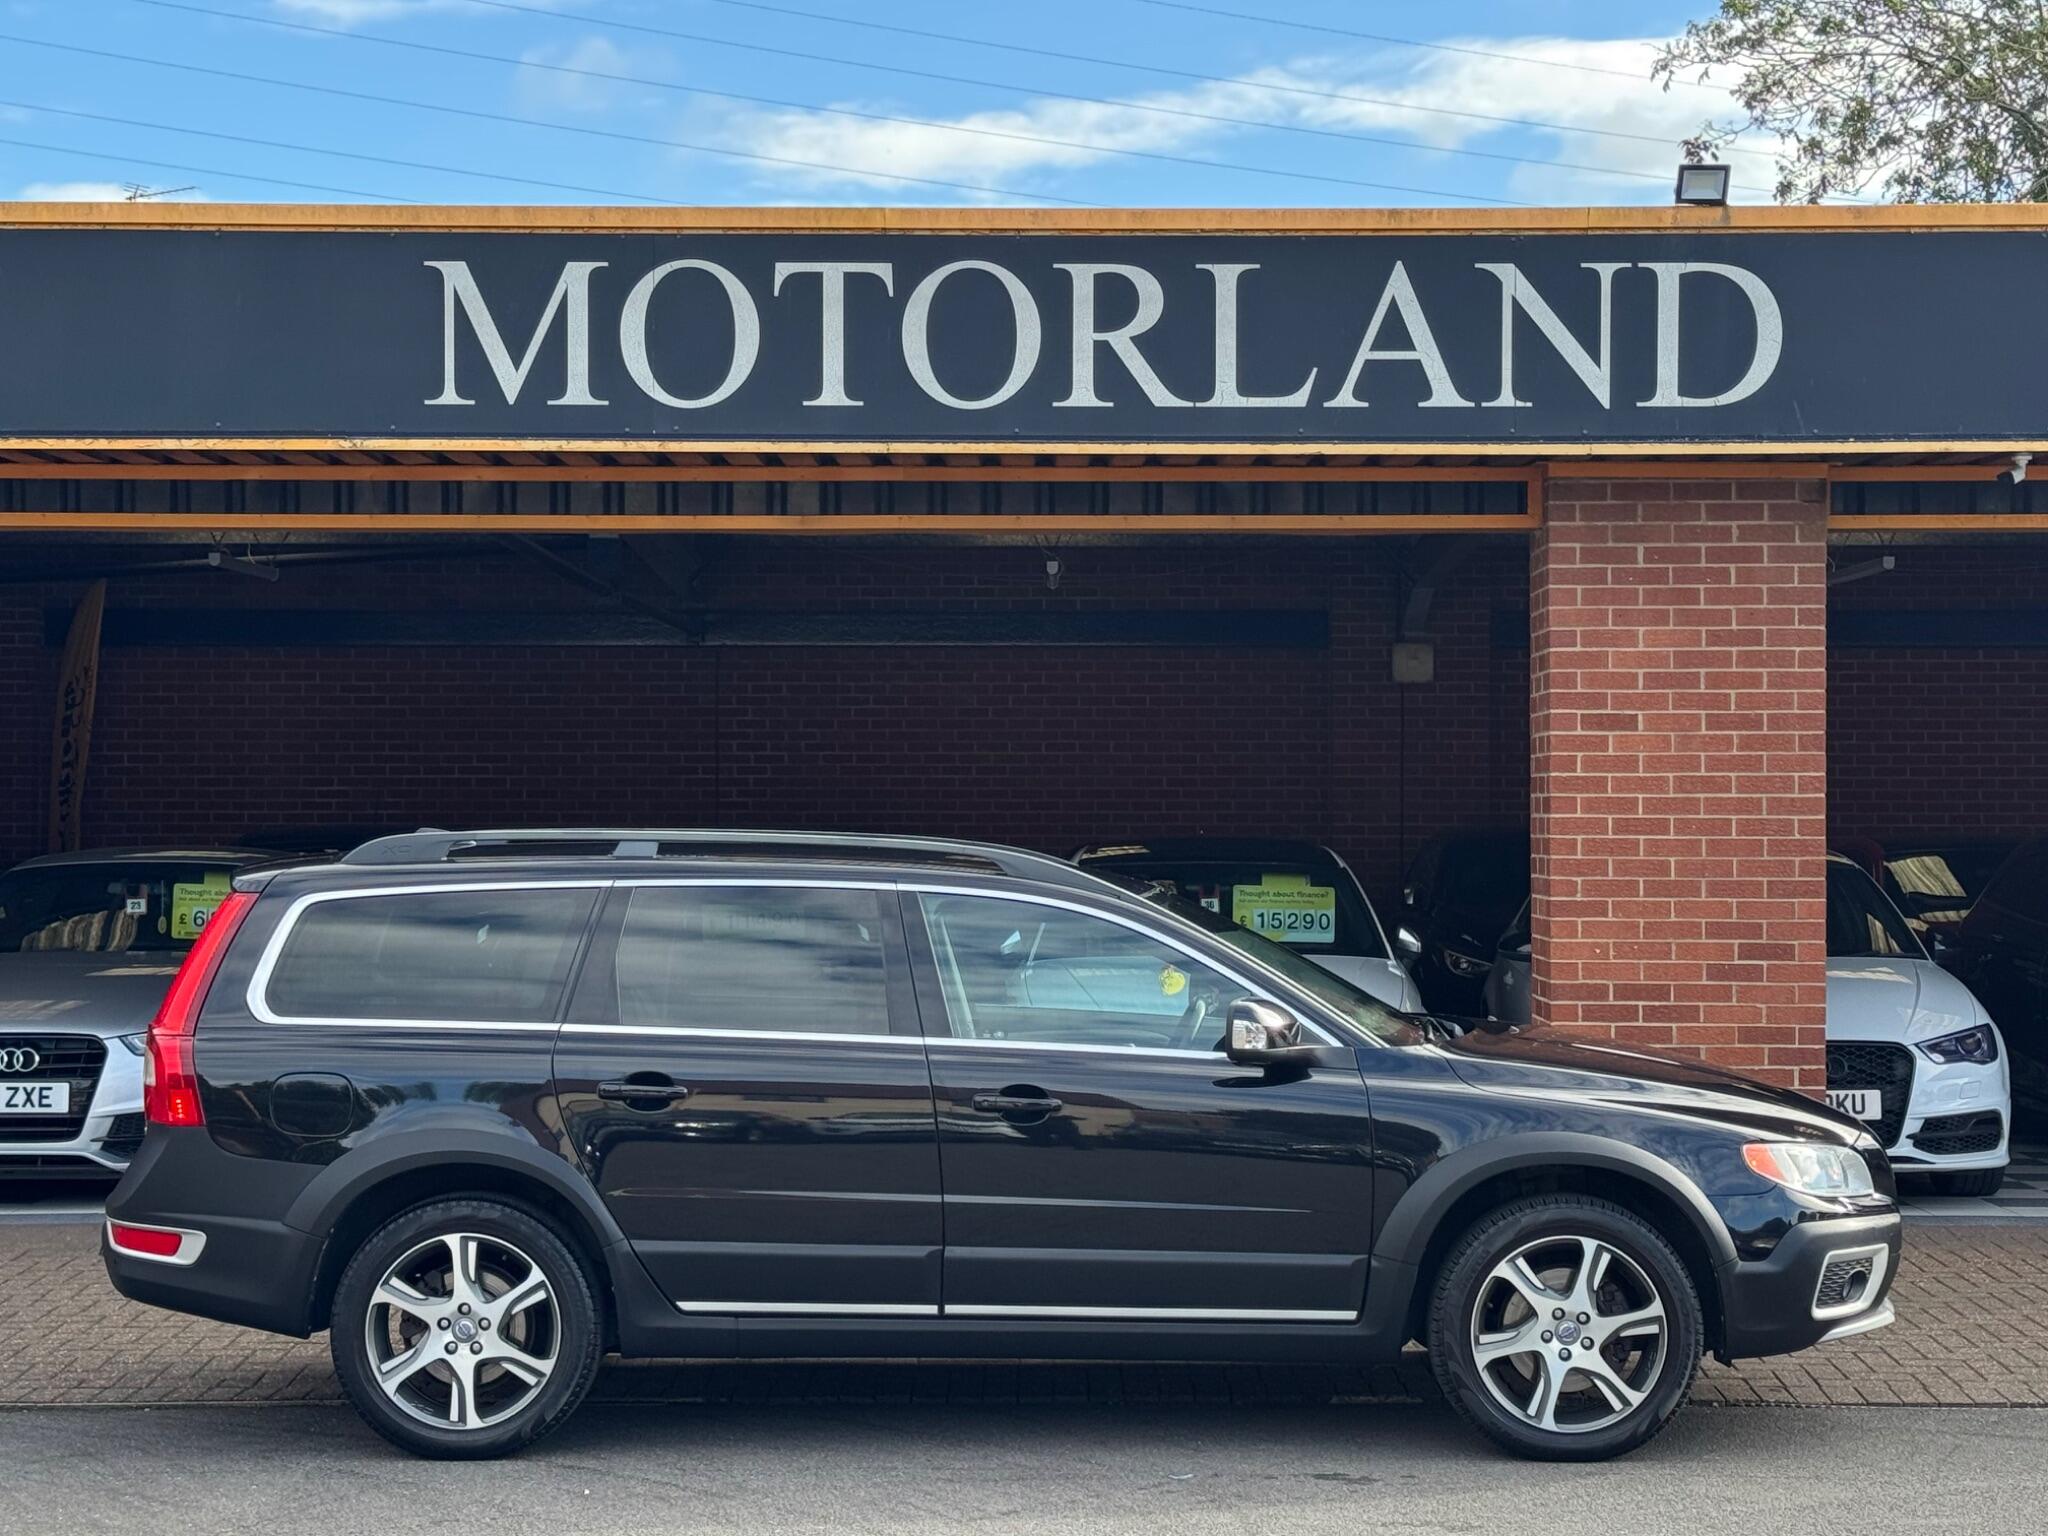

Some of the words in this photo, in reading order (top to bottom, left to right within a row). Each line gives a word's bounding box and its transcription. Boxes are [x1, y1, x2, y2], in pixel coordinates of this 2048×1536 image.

[423, 258, 1783, 411] MOTORLAND
[179, 888, 212, 897] Thought
[1239, 889, 1270, 899] Thought
[1272, 890, 1295, 898] about
[1296, 890, 1330, 899] finance?
[1257, 912, 1331, 930] 15290
[5, 1086, 53, 1108] ZXE
